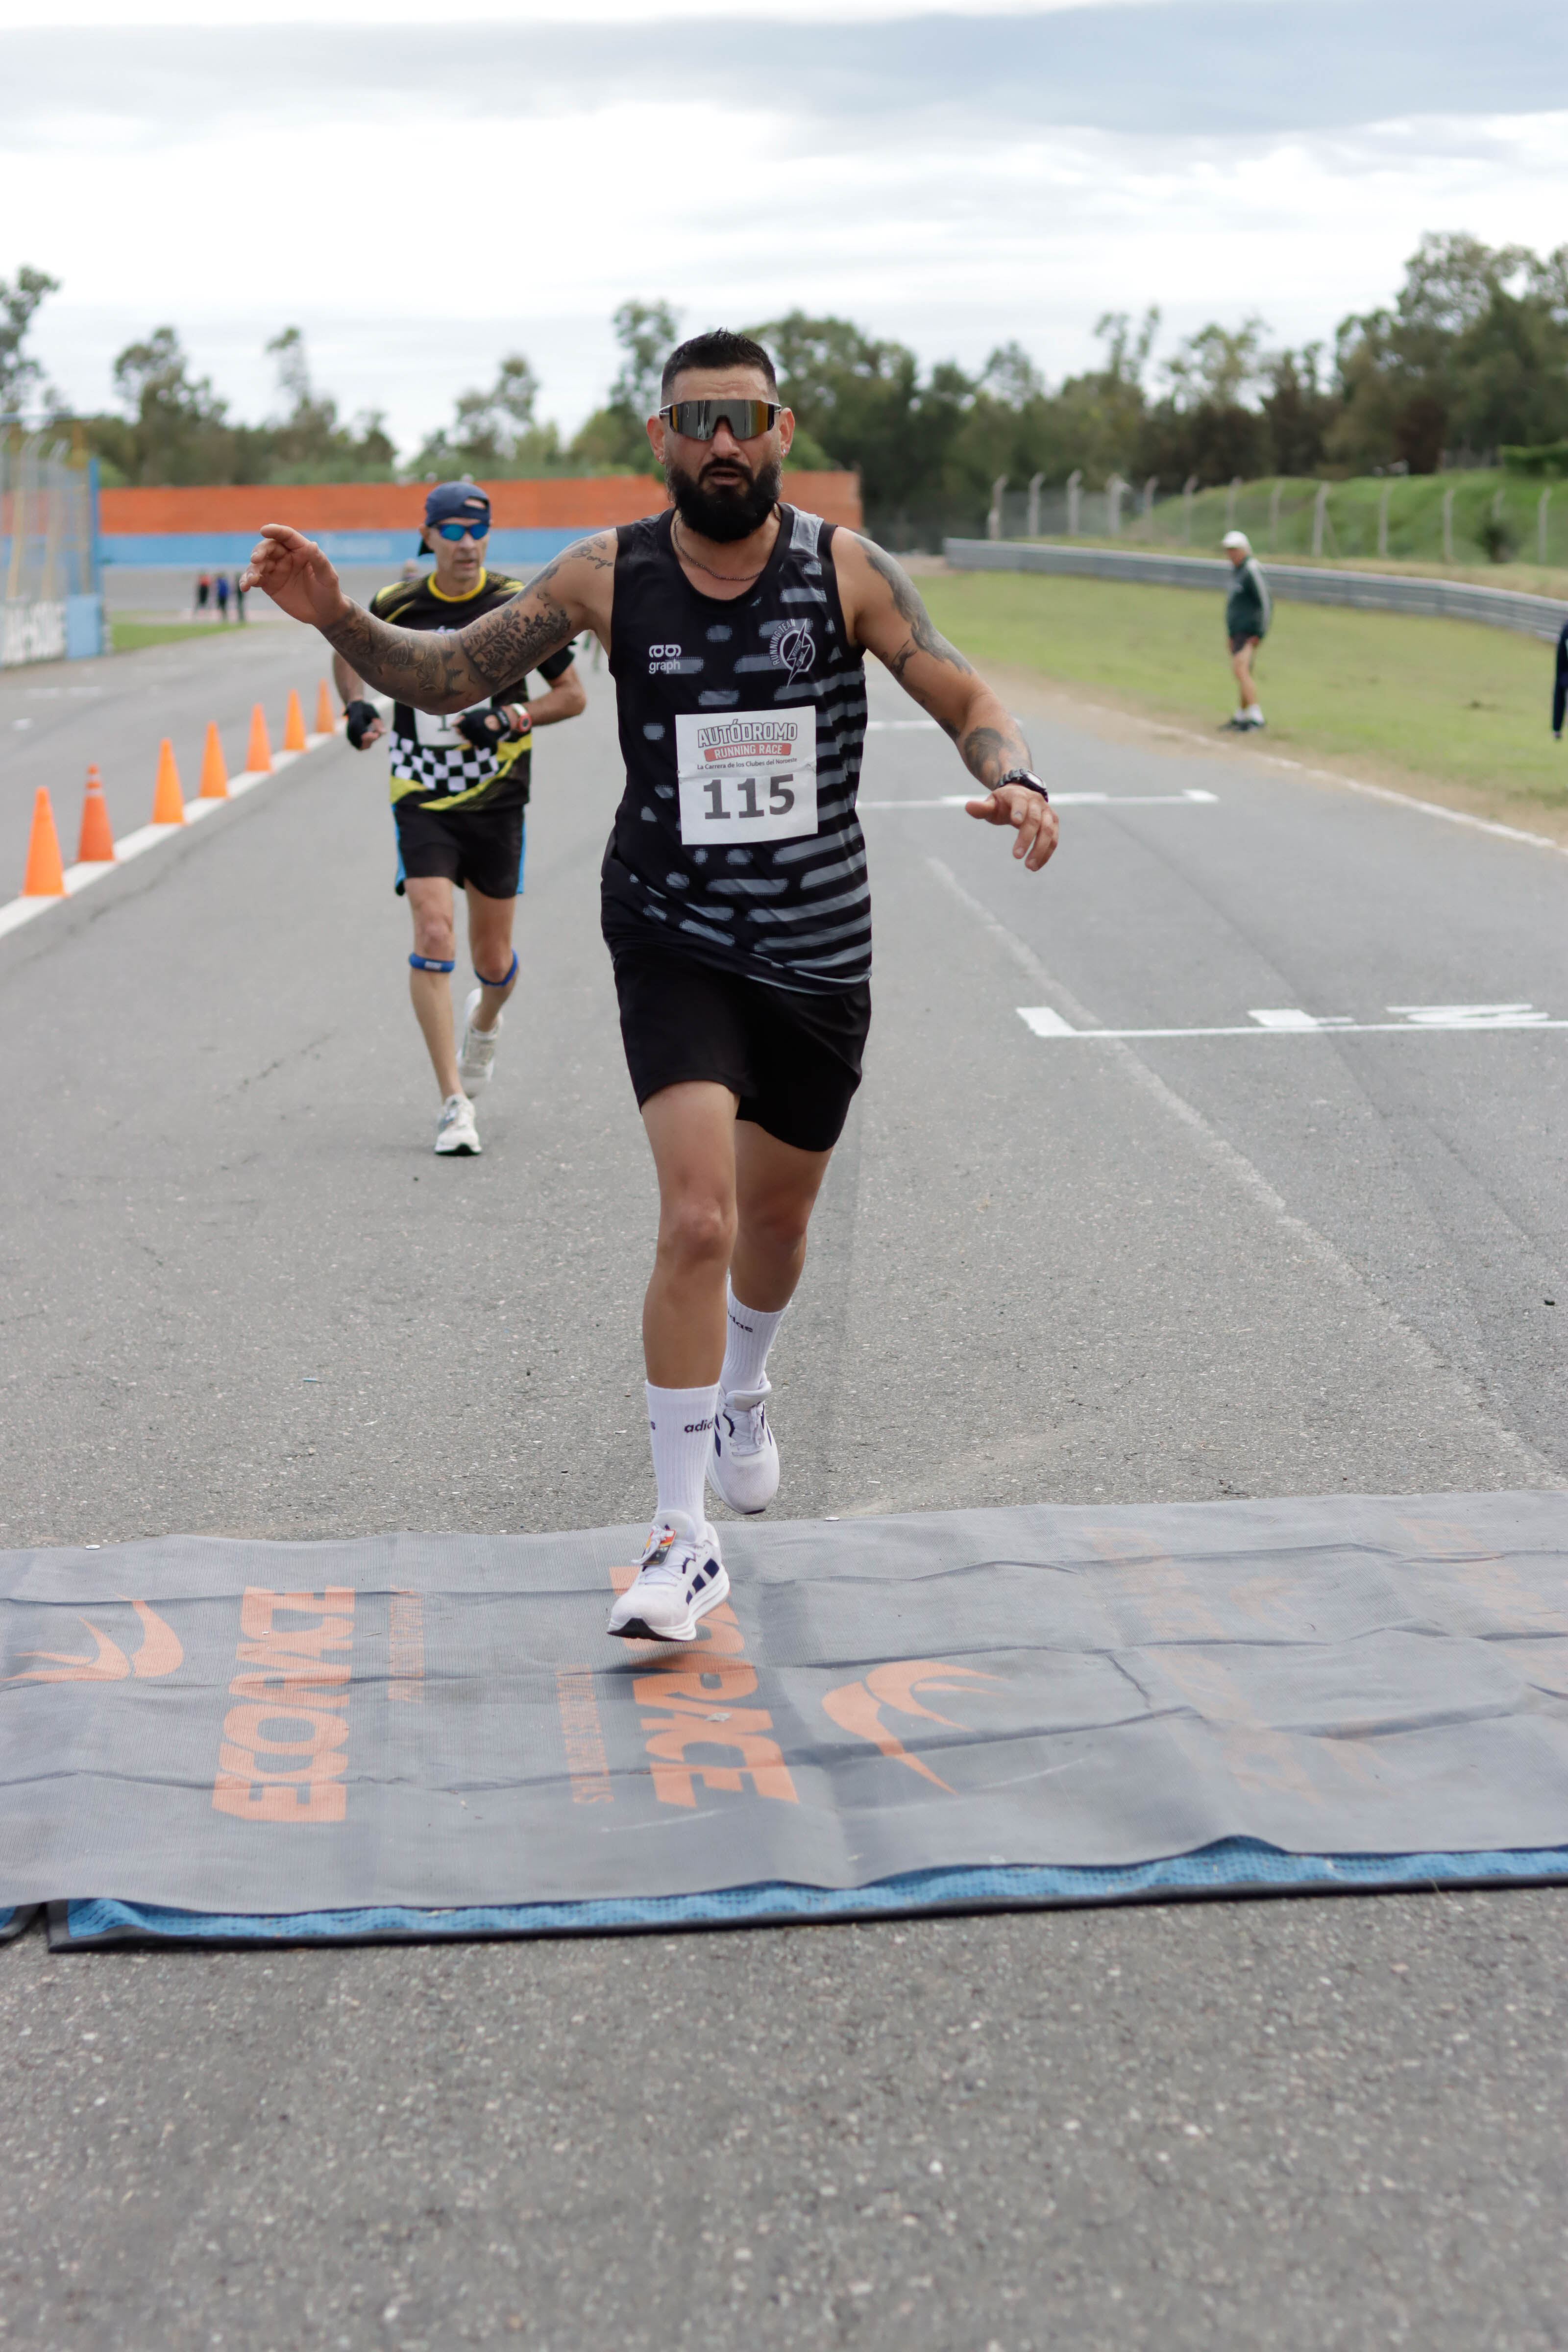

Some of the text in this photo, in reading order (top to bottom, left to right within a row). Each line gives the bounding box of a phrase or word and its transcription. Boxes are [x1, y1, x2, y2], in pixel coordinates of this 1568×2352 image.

[769, 618, 796, 665] RUNNING TEAM
[649, 659, 681, 674] graph
[698, 719, 798, 748] AUTÓDROMO
[714, 744, 783, 760] RUNNING RACE
[704, 774, 795, 819] 115
